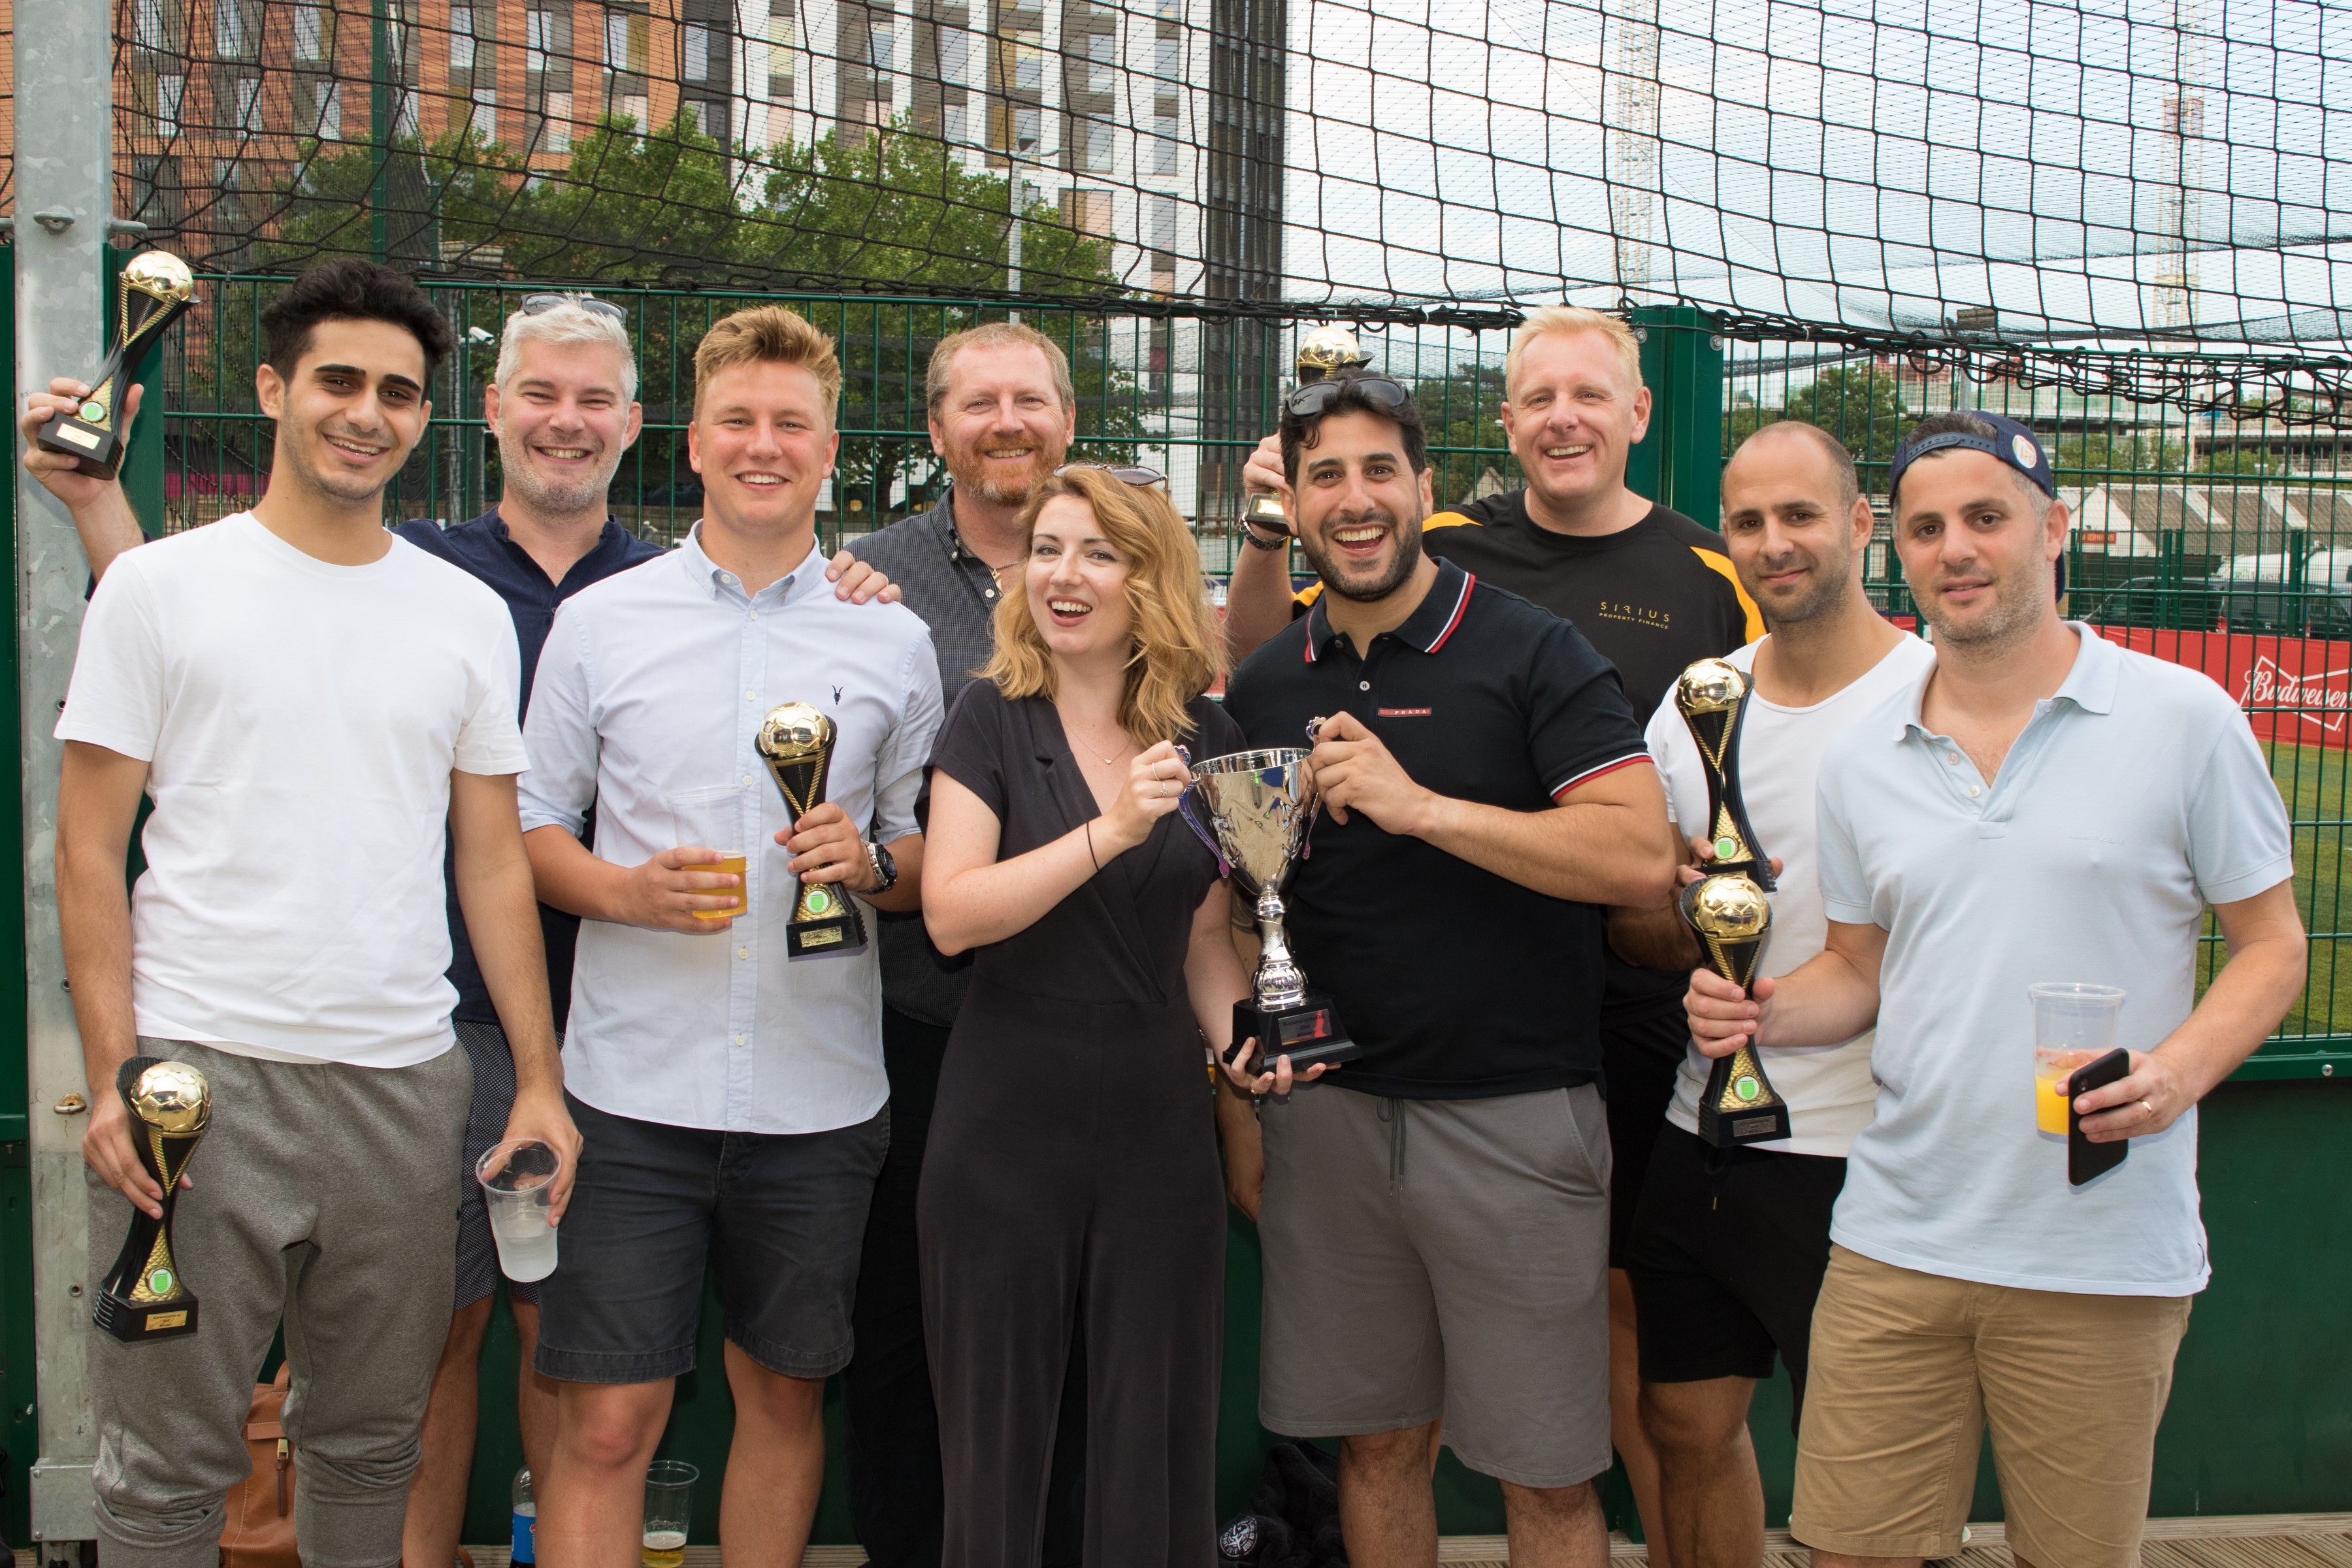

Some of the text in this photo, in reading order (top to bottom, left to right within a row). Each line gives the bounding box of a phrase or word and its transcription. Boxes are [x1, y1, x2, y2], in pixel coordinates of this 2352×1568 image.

[1599, 612, 1669, 630] PROPERTY FINANCE
[1600, 602, 1670, 622] SIRIUS
